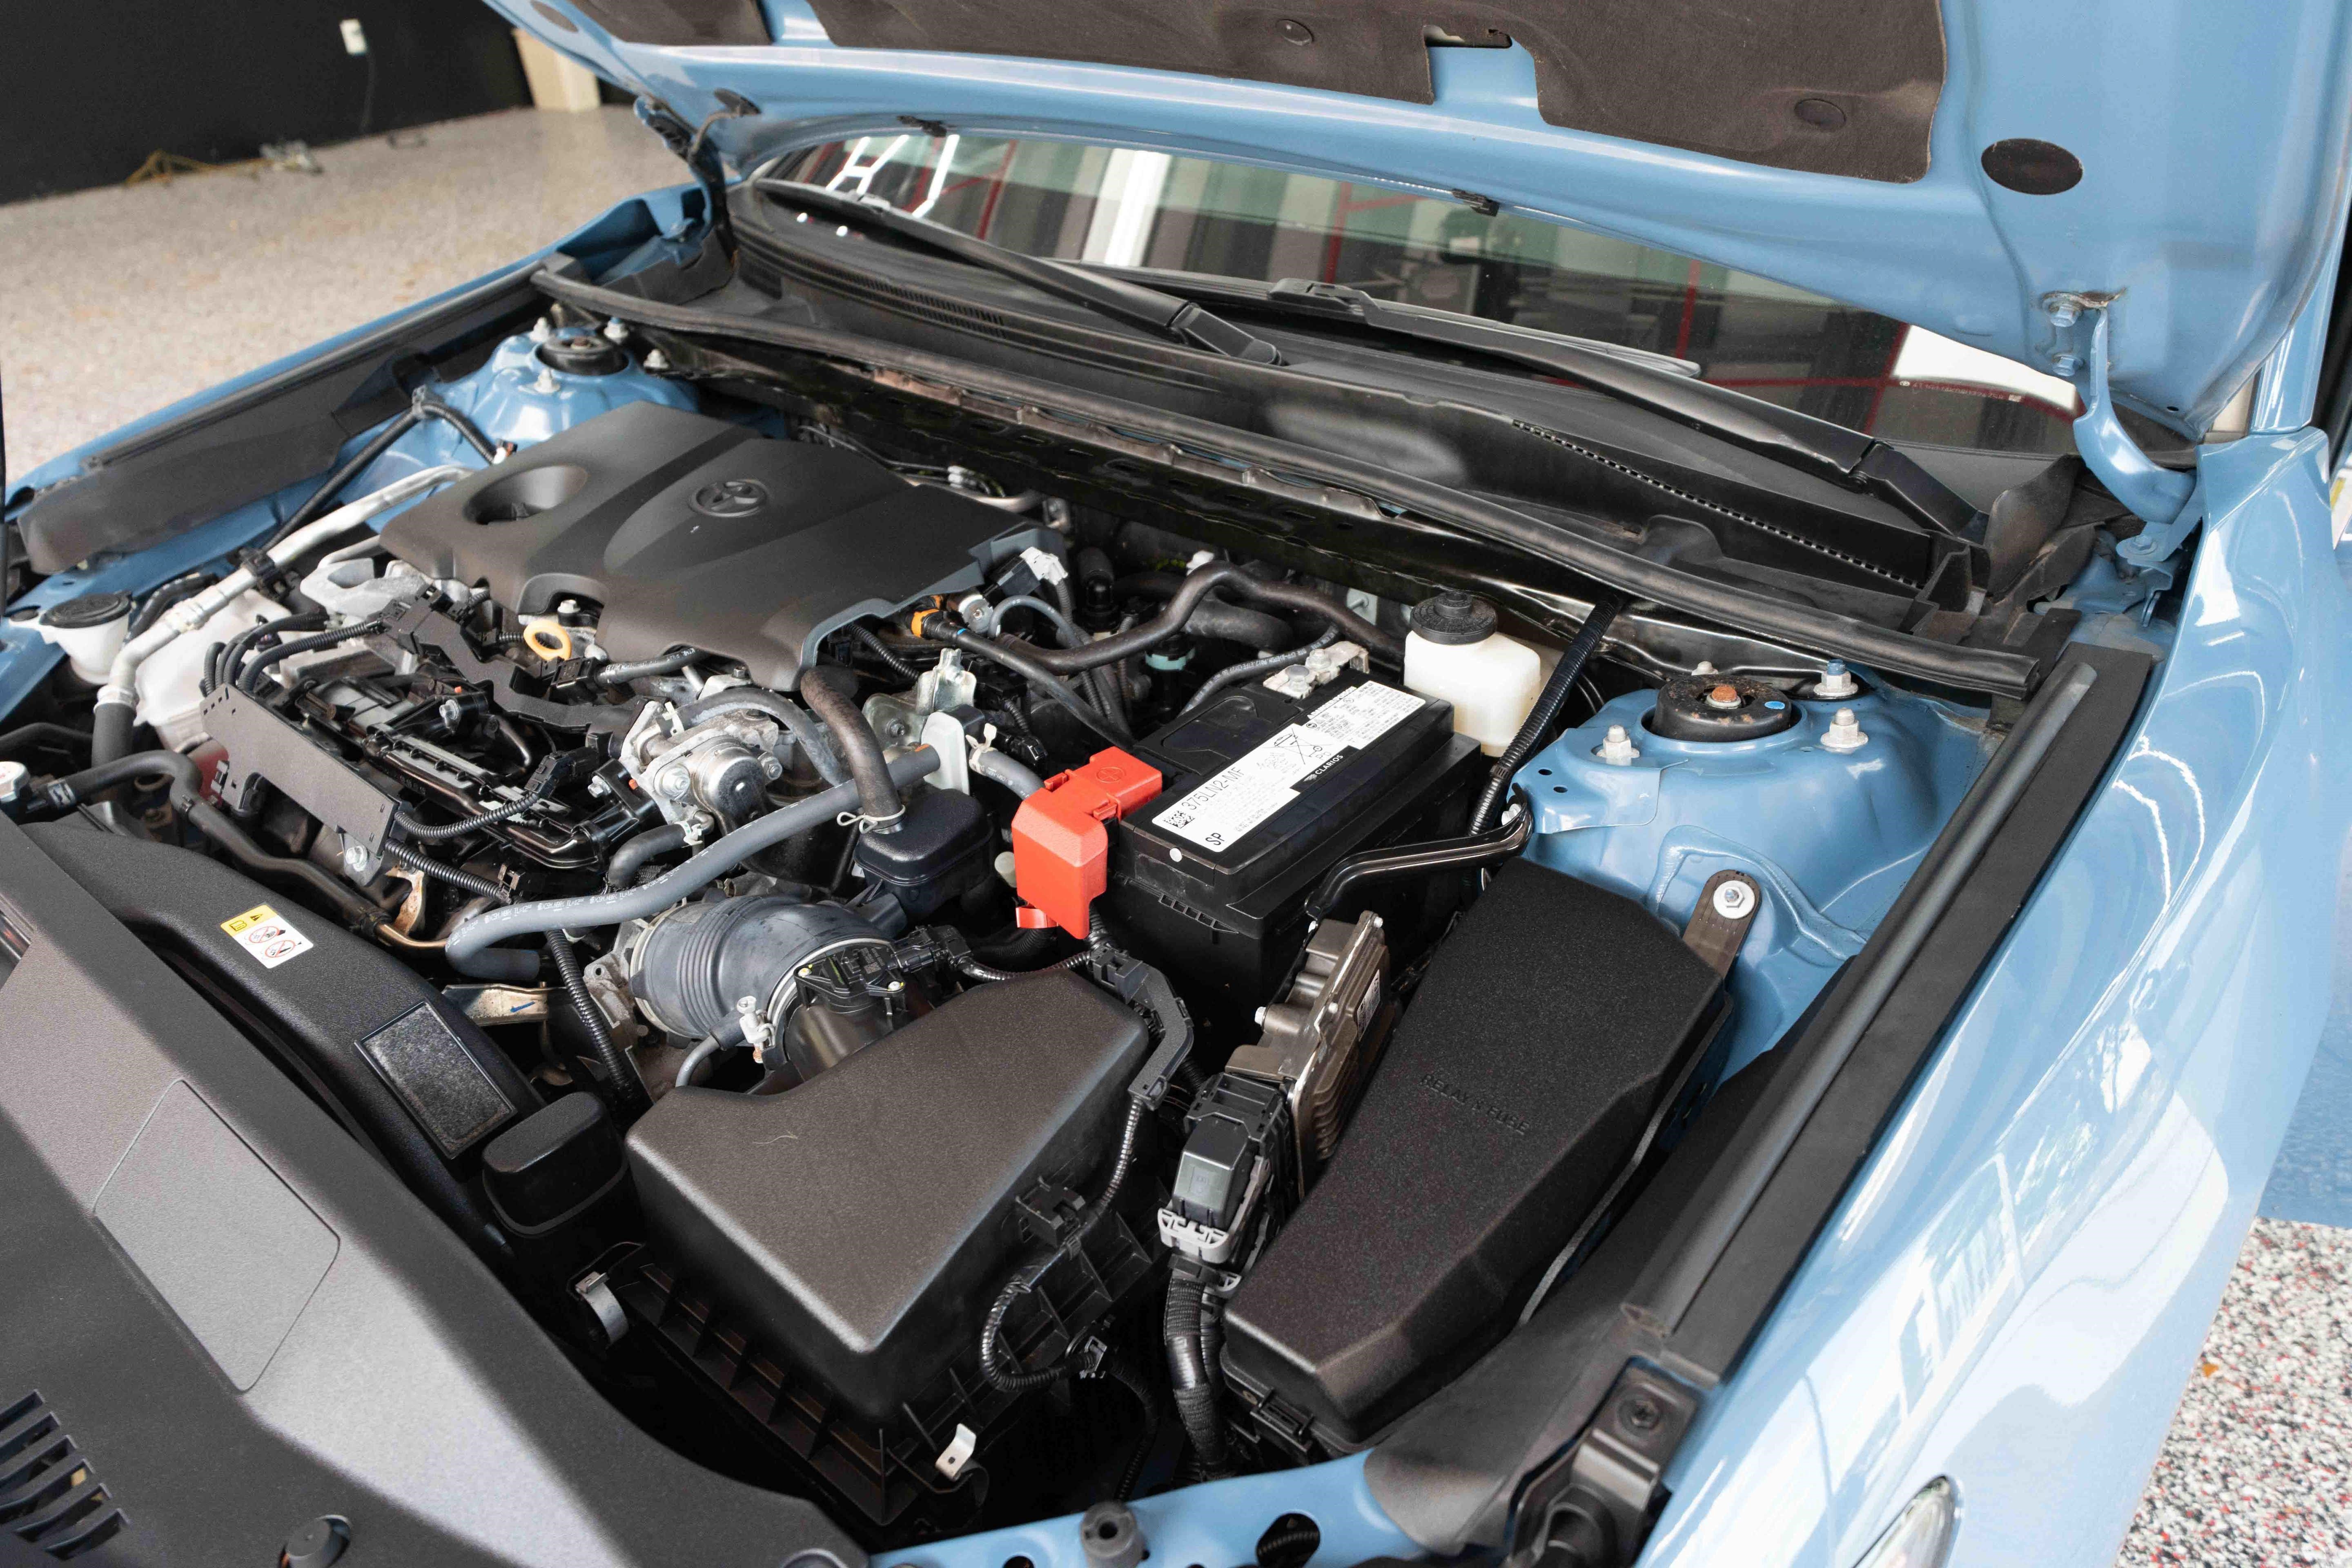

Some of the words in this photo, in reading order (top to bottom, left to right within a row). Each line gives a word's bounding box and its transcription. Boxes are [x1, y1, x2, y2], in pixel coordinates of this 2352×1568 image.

[1315, 755, 1343, 775] CLARIOS
[1181, 766, 1244, 811] 375LN2-MF
[1205, 832, 1225, 845] SP
